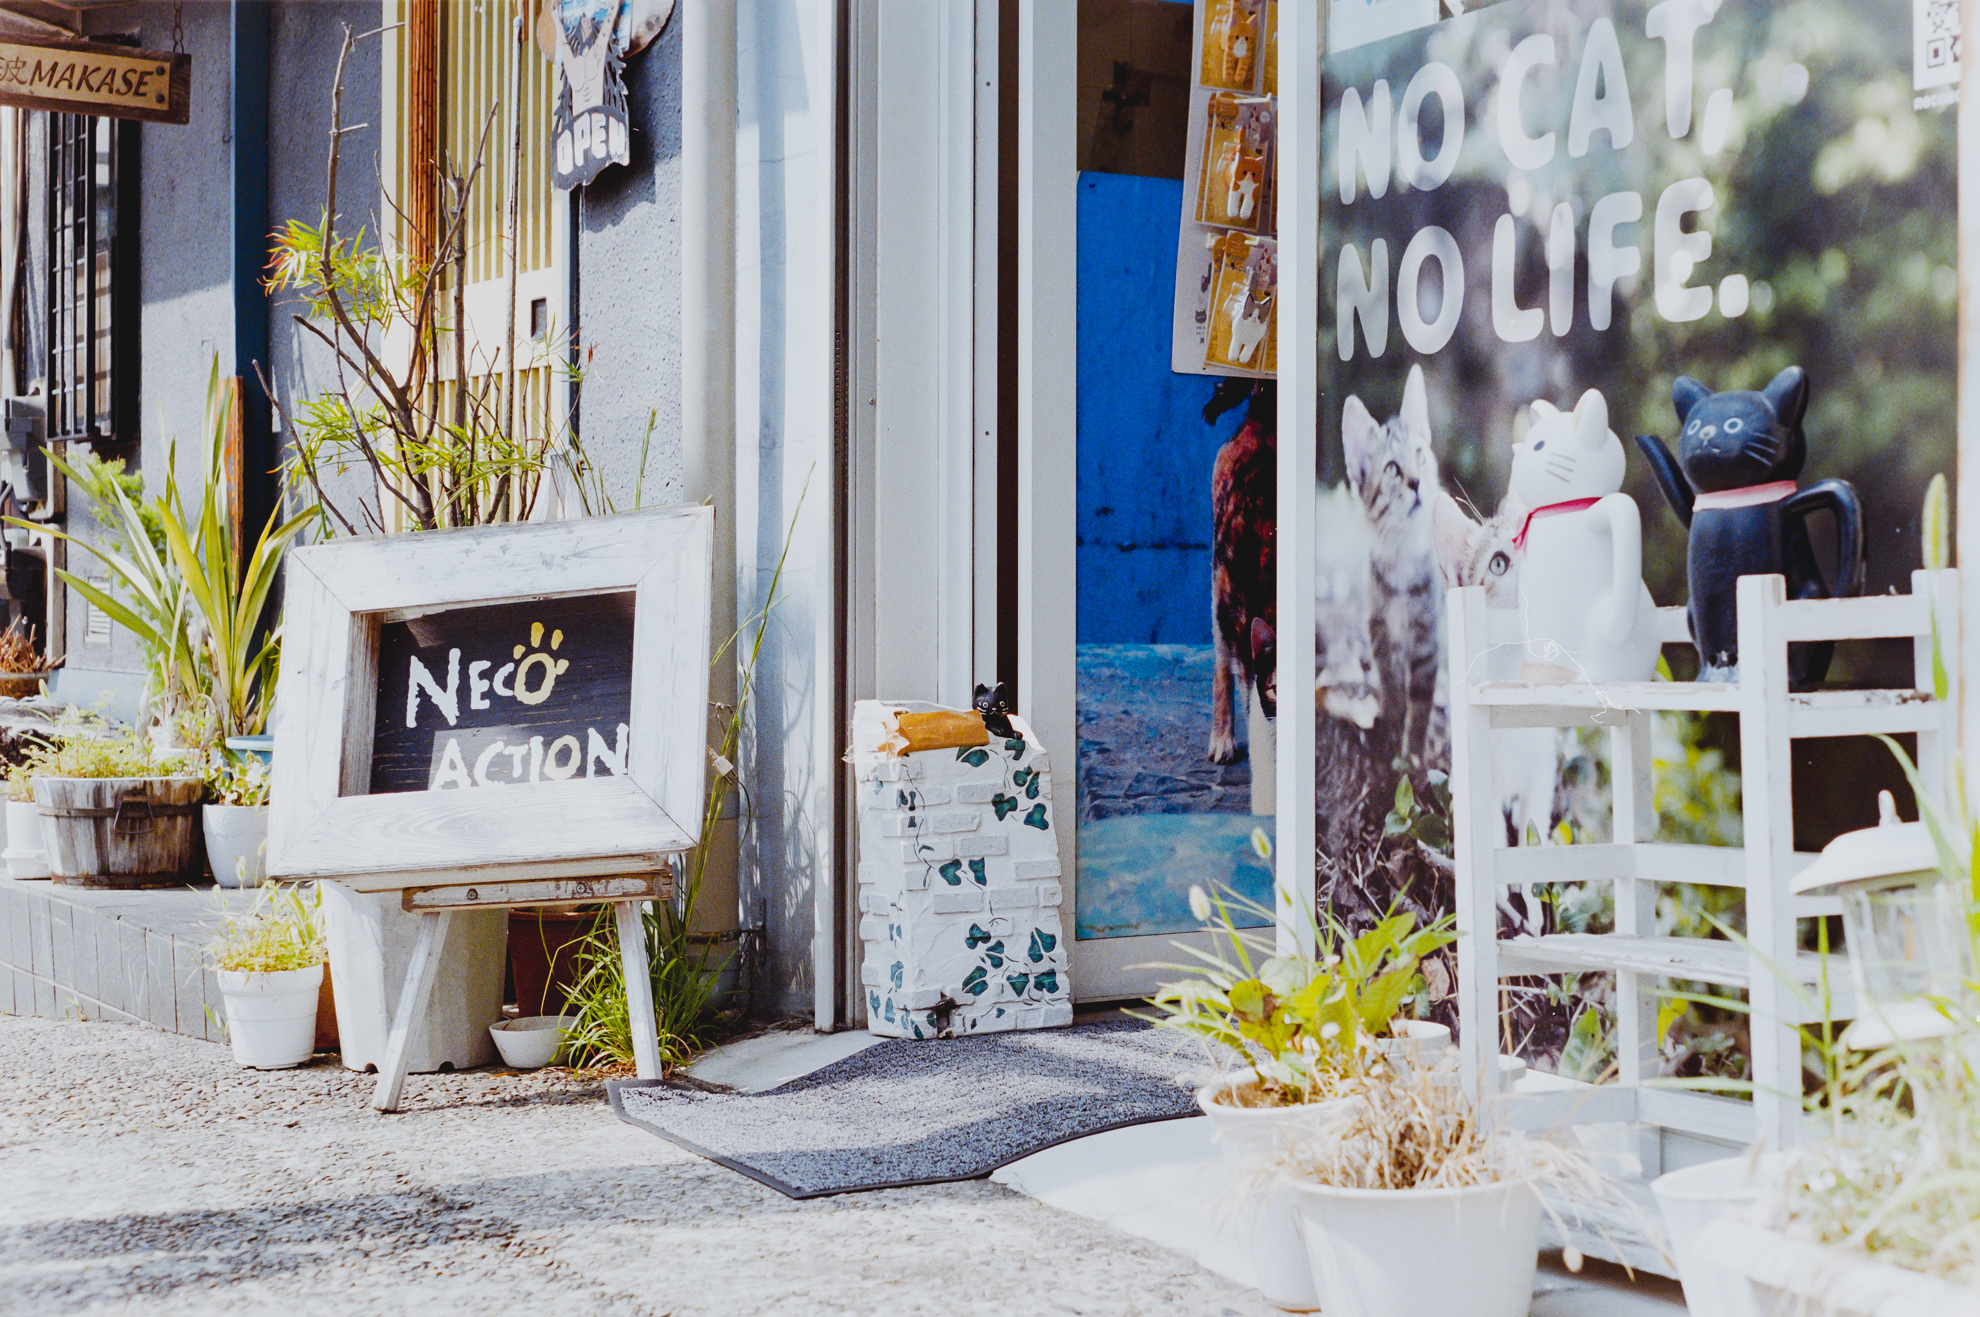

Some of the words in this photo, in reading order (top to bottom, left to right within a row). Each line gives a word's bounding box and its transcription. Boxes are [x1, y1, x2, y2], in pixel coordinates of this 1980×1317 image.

[556, 111, 627, 176] OPEN
[1338, 61, 1466, 205] NO
[1500, 0, 1734, 170] CAT,
[1336, 225, 1466, 362] NO
[1491, 177, 1749, 343] LIFE.
[427, 722, 630, 791] ACTION
